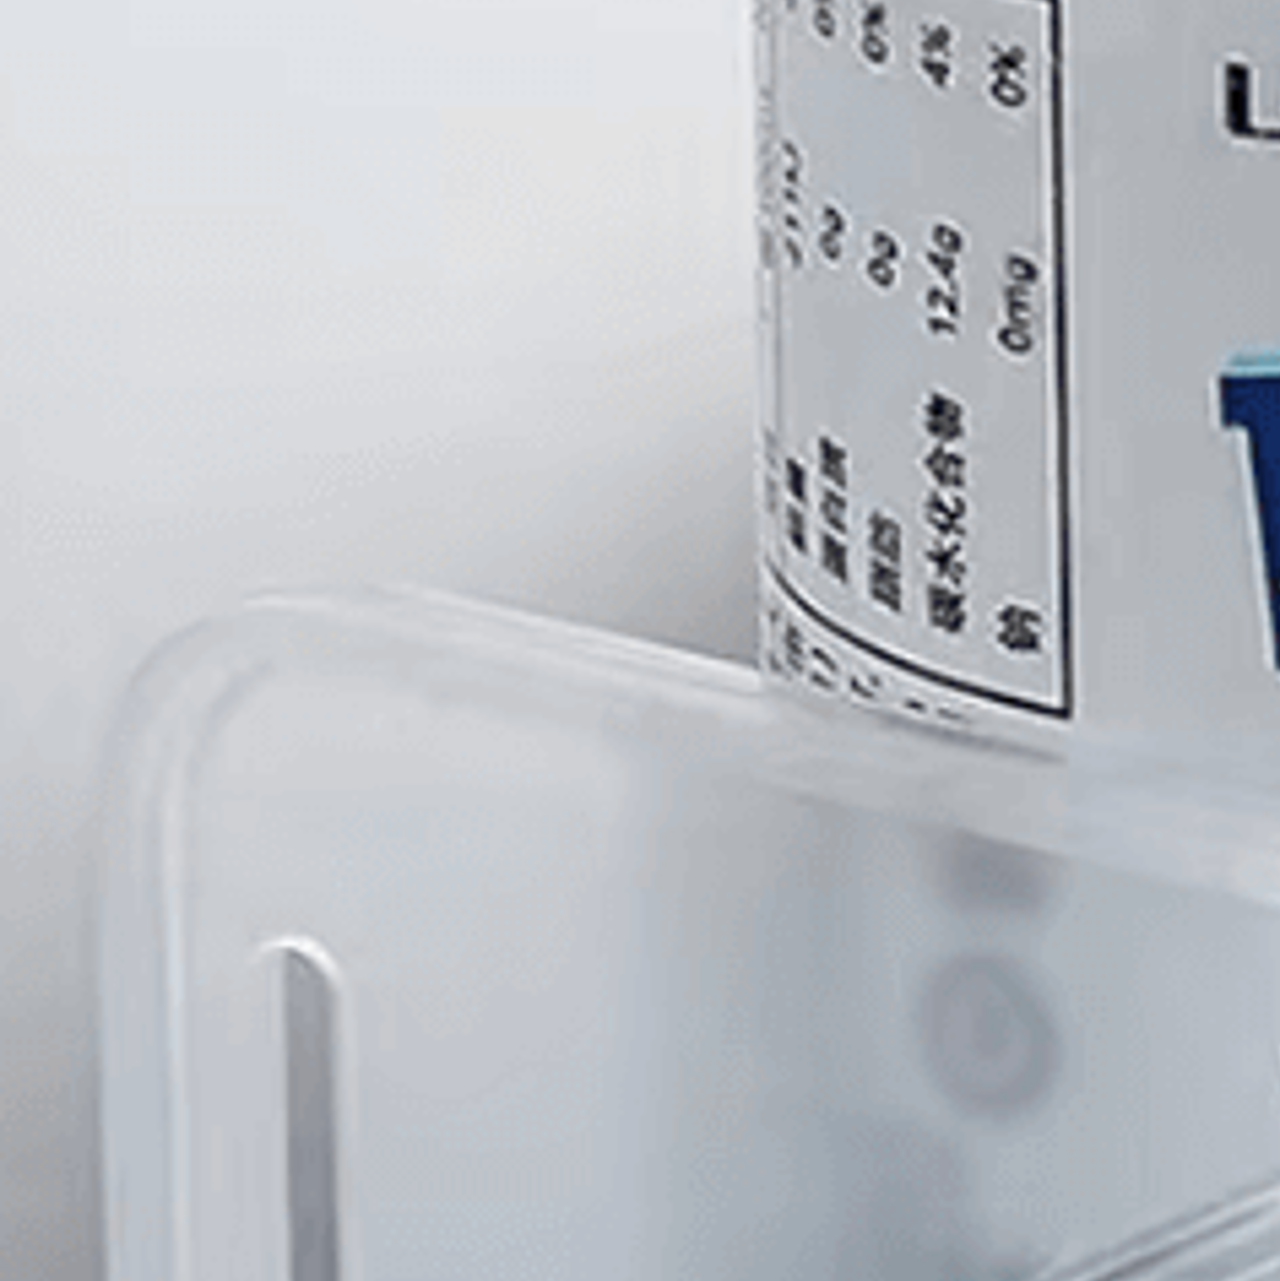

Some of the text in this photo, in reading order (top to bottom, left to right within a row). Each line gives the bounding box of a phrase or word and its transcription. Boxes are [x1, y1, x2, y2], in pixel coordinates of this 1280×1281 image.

[920, 22, 952, 87] 4%
[990, 42, 1028, 108] 0%
[926, 223, 963, 335] 12.4g
[998, 254, 1038, 355] 0mg
